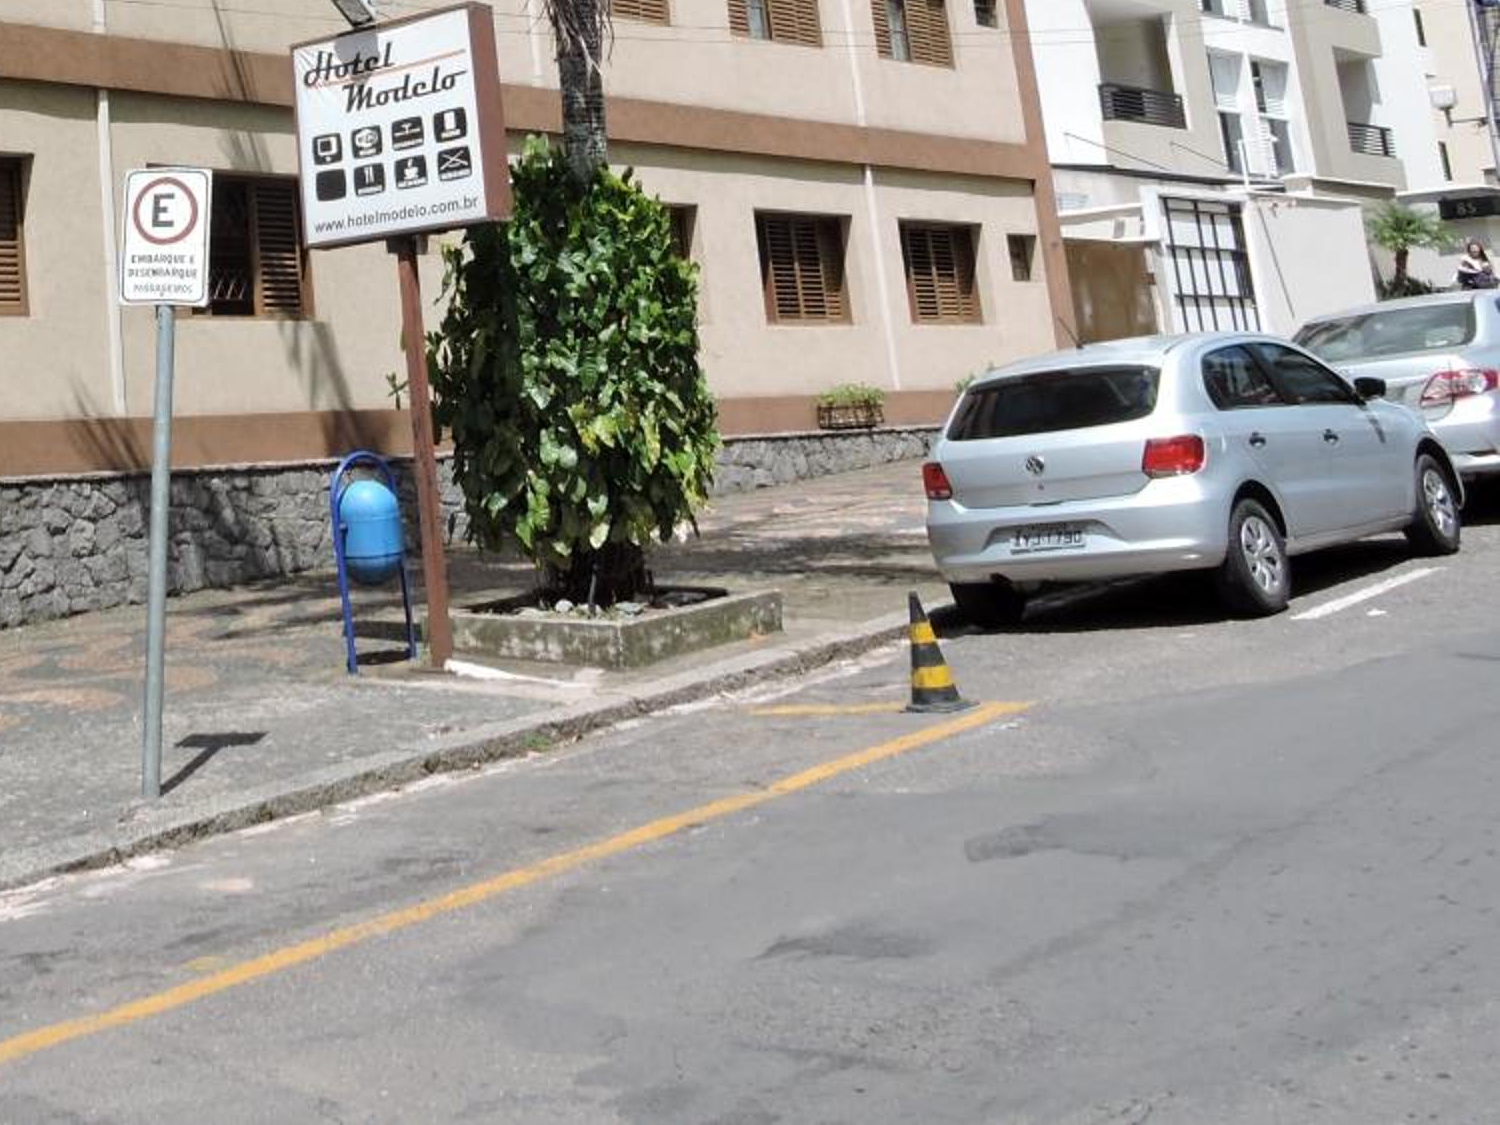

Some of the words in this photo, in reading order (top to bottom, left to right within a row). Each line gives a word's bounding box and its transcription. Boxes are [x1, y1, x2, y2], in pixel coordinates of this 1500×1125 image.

[303, 42, 395, 88] Hotel
[342, 66, 467, 113] Modelo
[151, 192, 175, 228] E
[314, 195, 478, 232] www.hotelmodelo.com.br
